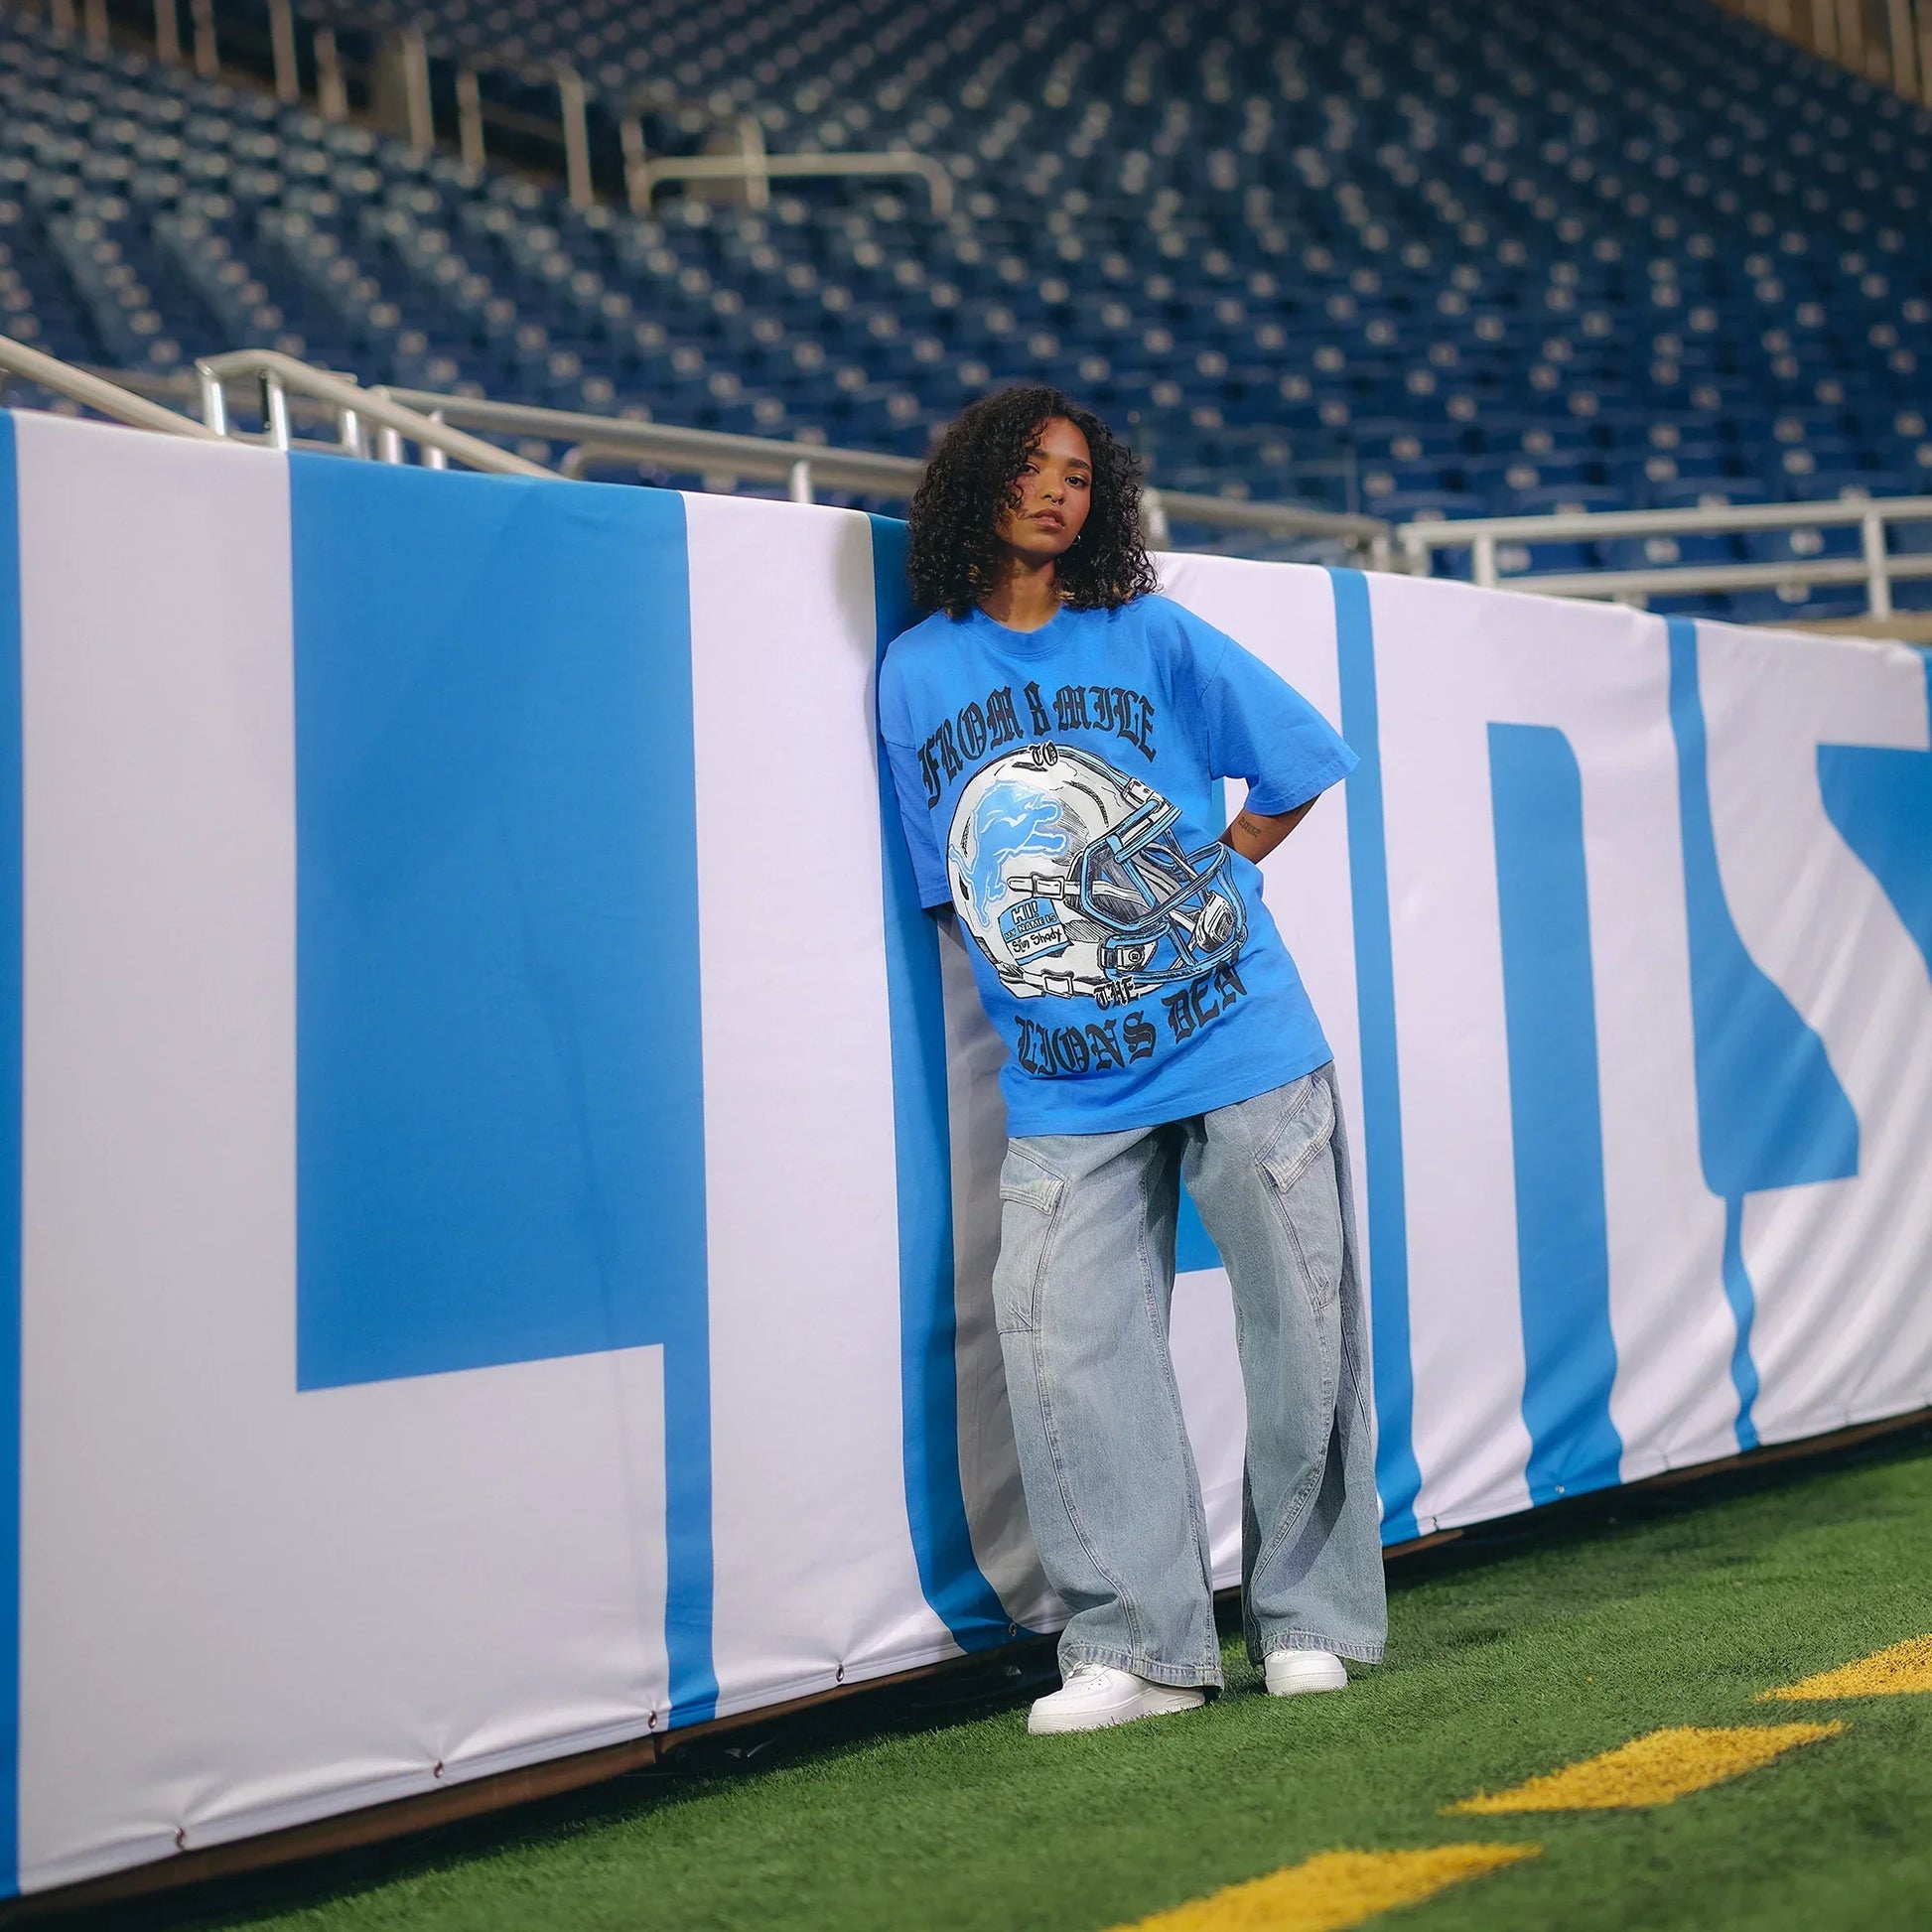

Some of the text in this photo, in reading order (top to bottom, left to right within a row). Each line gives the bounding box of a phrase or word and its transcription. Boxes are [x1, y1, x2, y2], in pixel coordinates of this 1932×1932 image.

[917, 680, 1158, 810] FROM 8 MILE
[1029, 741, 1059, 766] TO
[1012, 899, 1039, 925] HI!
[1005, 913, 1057, 940] MY NAME IS
[1031, 927, 1062, 945] Shady
[1093, 976, 1141, 1011] THE
[1014, 945, 1248, 1076] LIONS DEN
